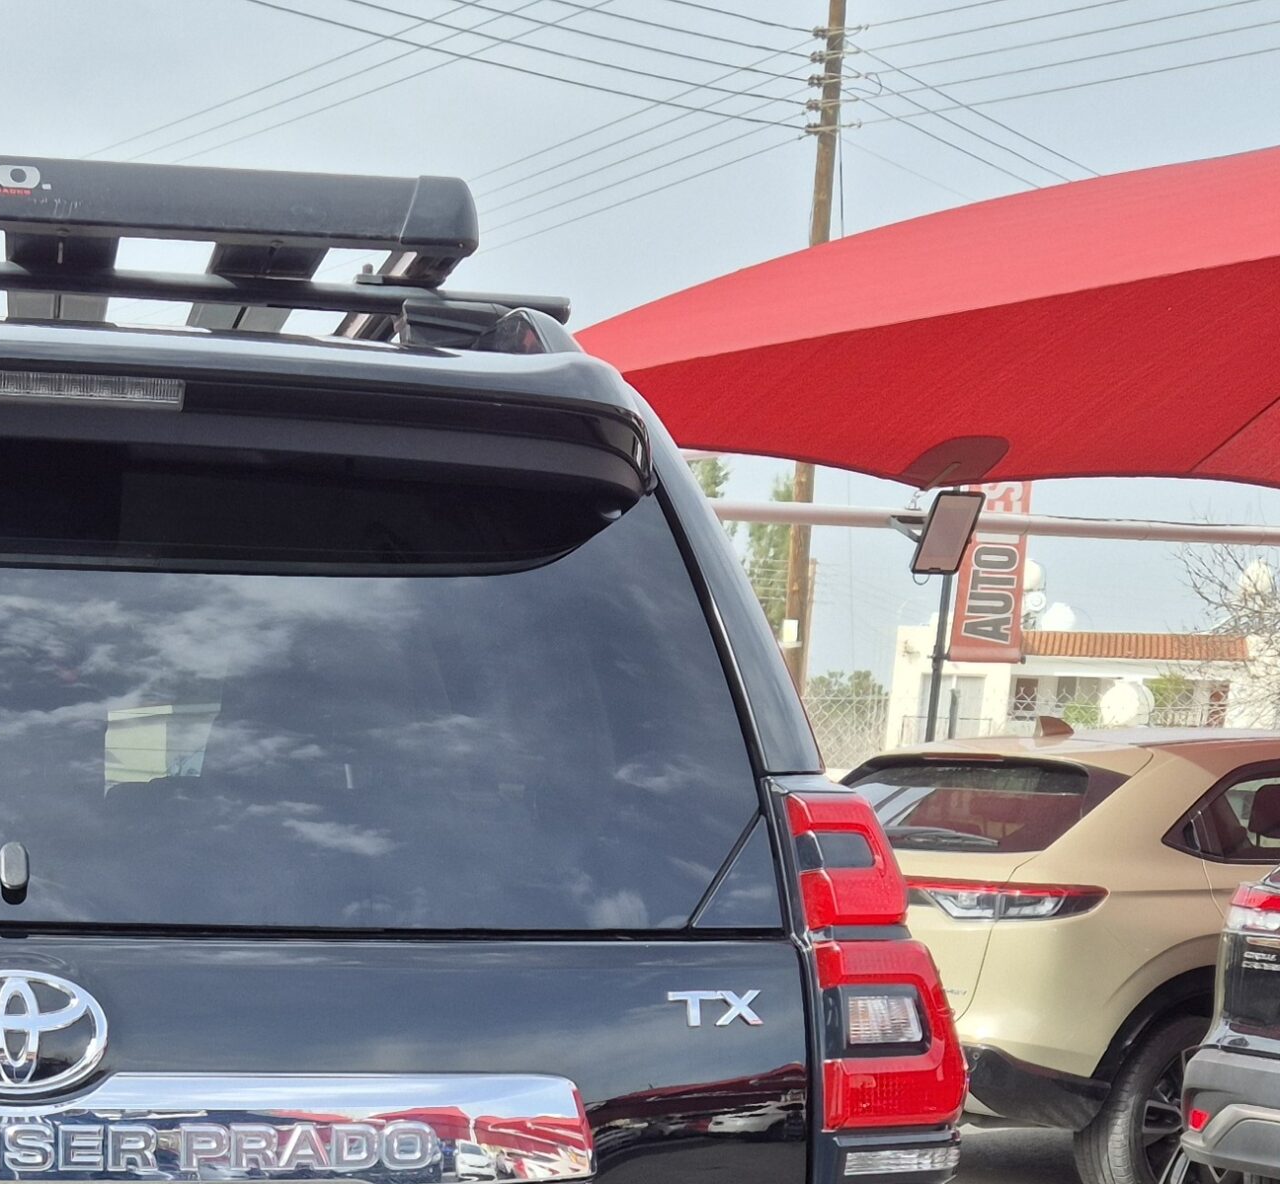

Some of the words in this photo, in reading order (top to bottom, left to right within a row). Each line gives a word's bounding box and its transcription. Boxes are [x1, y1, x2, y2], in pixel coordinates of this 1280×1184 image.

[961, 543, 1020, 645] AUTO
[667, 989, 764, 1027] TX
[179, 1119, 437, 1171] PRADO
